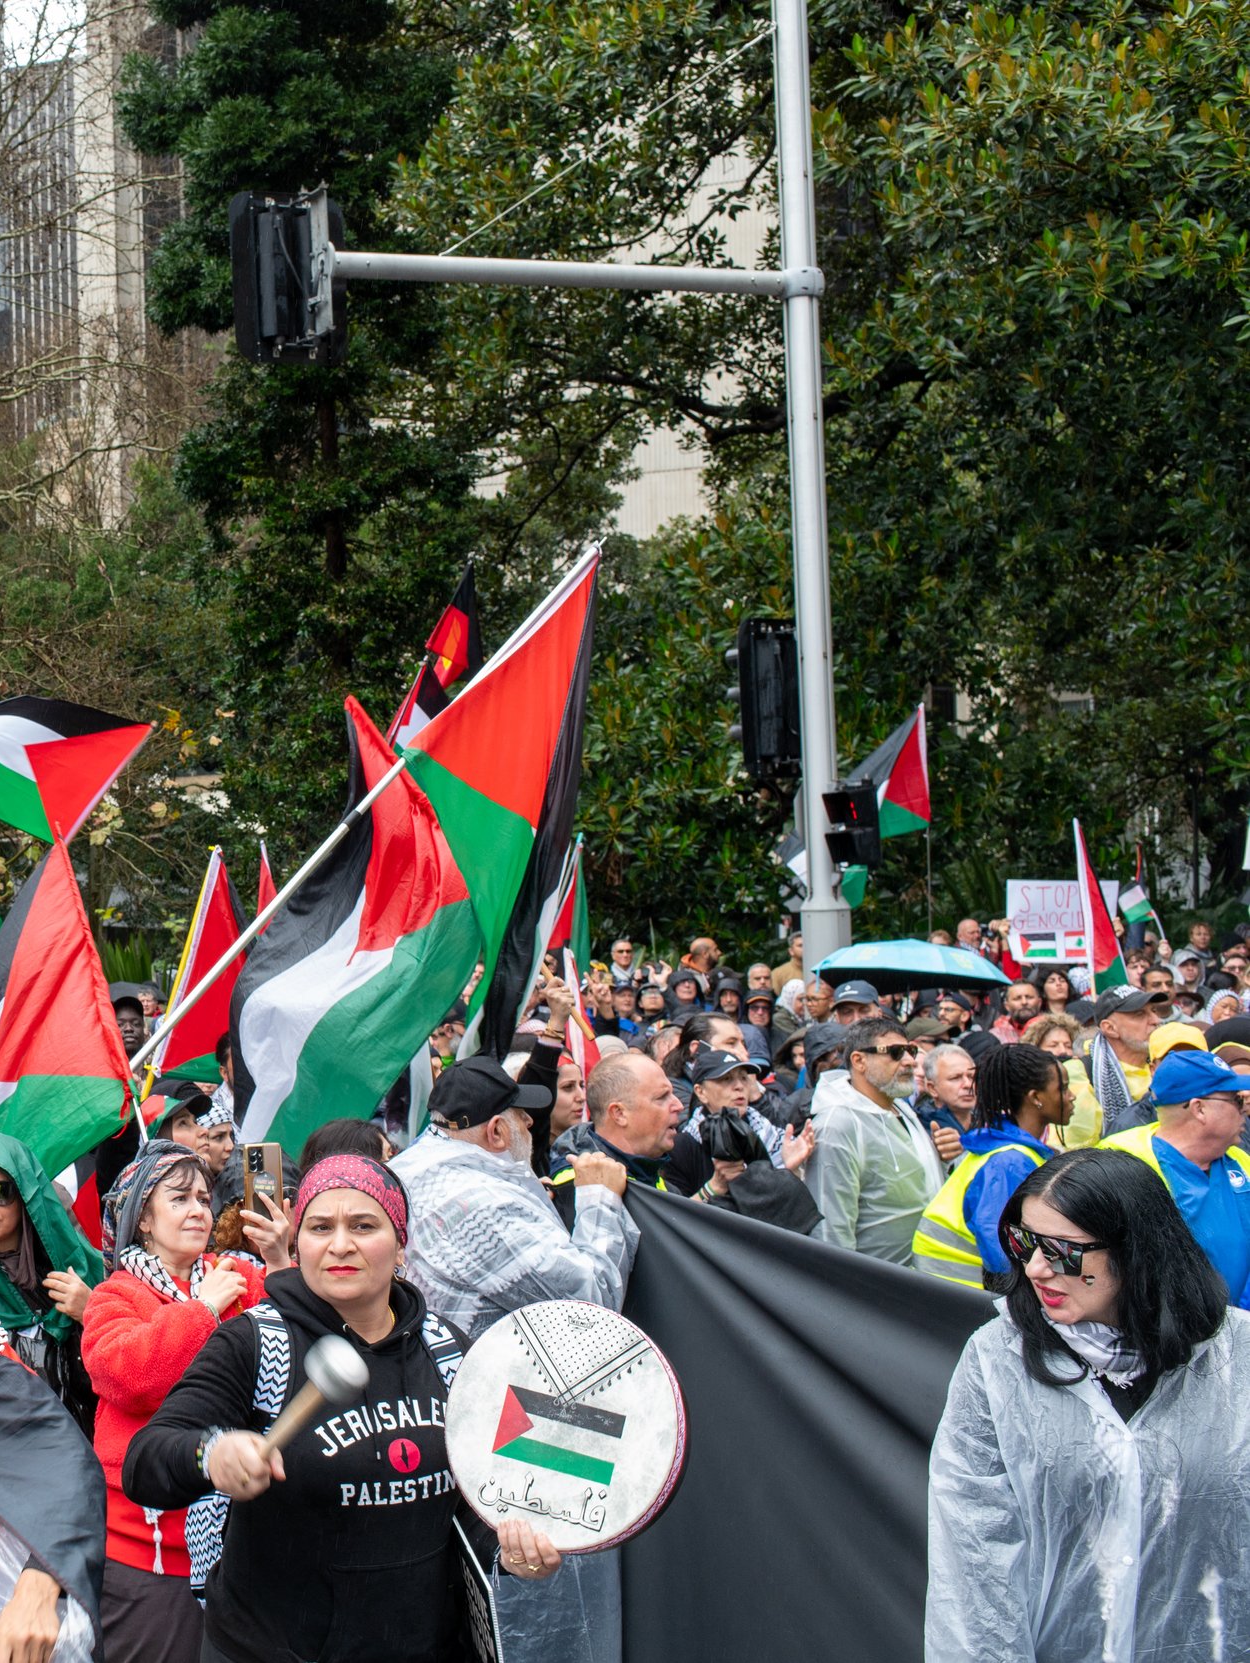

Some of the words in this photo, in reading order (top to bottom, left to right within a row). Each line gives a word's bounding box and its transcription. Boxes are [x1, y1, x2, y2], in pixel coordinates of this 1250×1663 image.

[1019, 884, 1078, 914] STOP
[1012, 911, 1085, 931] GENOCID
[314, 1396, 447, 1457] JERUSALE
[340, 1469, 457, 1507] PALESTIN
[477, 1471, 607, 1532] فلسطين
